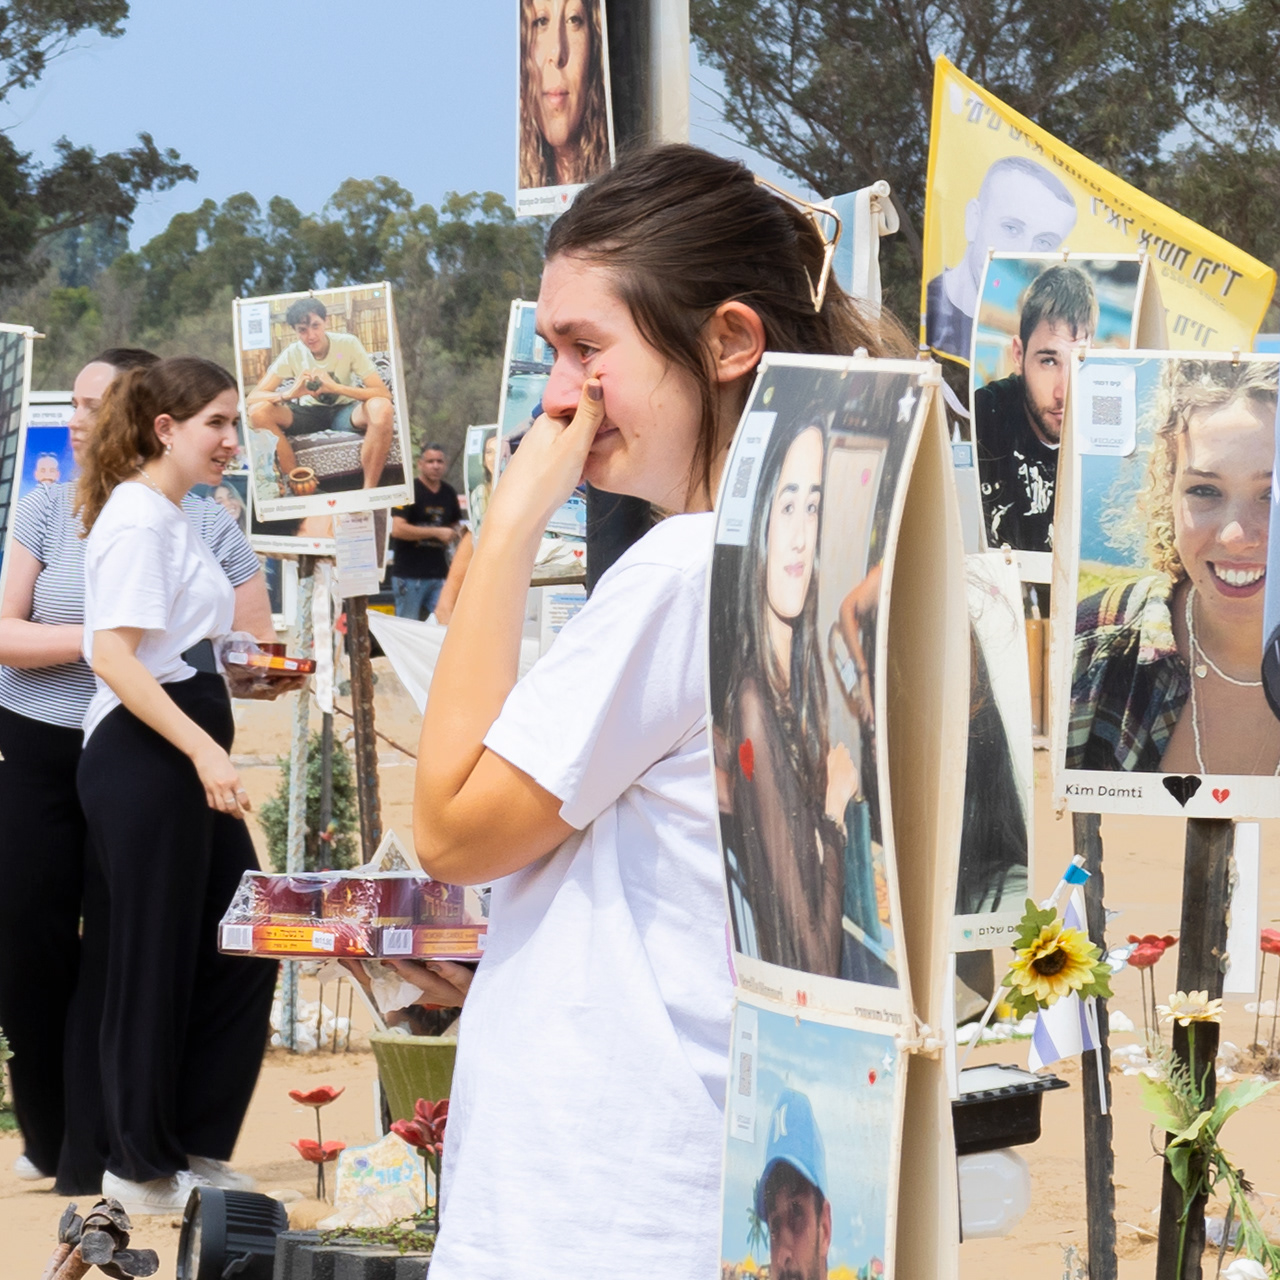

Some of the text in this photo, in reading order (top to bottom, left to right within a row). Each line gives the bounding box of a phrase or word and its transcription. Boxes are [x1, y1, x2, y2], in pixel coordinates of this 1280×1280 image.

[1065, 784, 1143, 799] Kim Damti
[978, 924, 1005, 936] שלום
